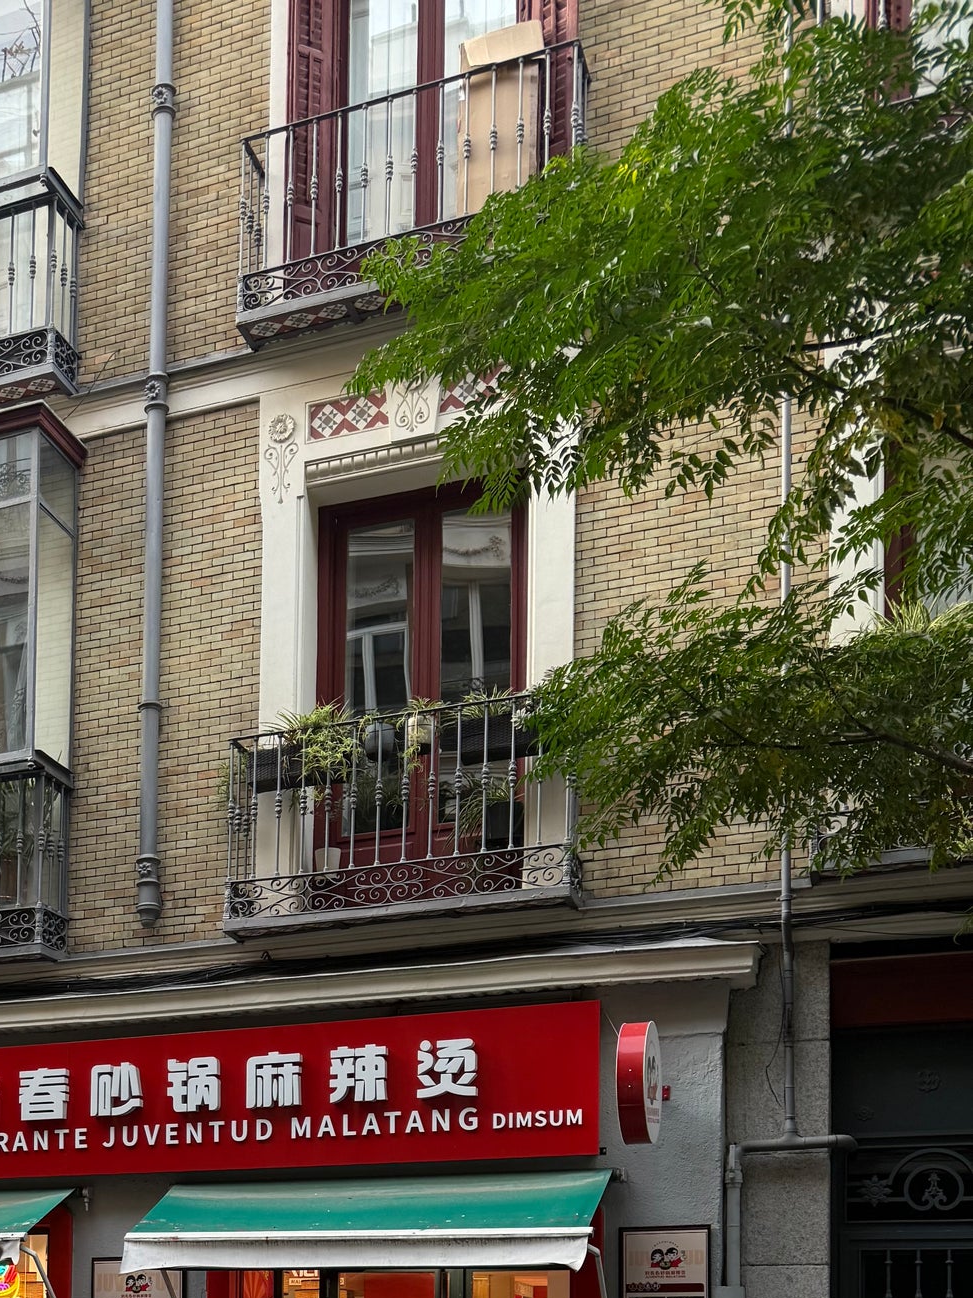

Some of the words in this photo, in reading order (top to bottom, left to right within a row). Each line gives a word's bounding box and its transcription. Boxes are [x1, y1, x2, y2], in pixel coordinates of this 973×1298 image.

[102, 1118, 274, 1148] JUVENTUD
[290, 1106, 480, 1140] MALATANG
[491, 1108, 584, 1131] DIMSUM
